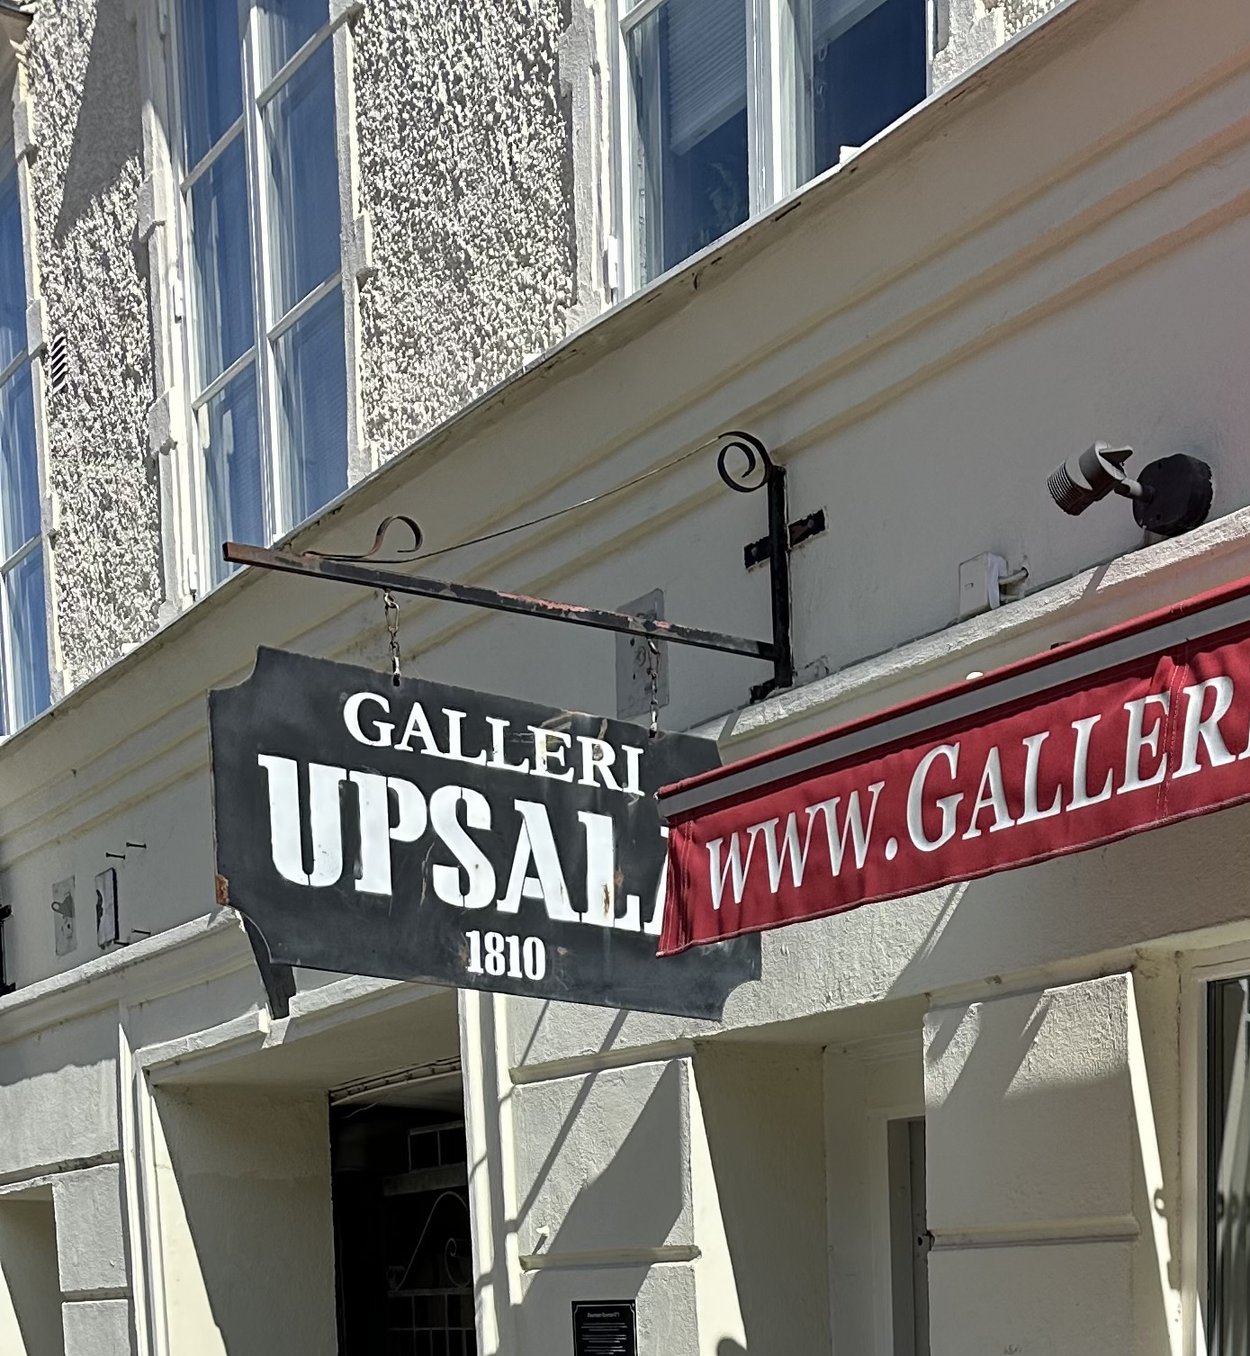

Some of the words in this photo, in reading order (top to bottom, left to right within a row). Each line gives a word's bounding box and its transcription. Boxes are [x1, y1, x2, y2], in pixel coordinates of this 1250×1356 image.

[343, 691, 646, 797] GALLERI
[257, 753, 668, 937] UPSAL
[465, 929, 546, 981] 1810
